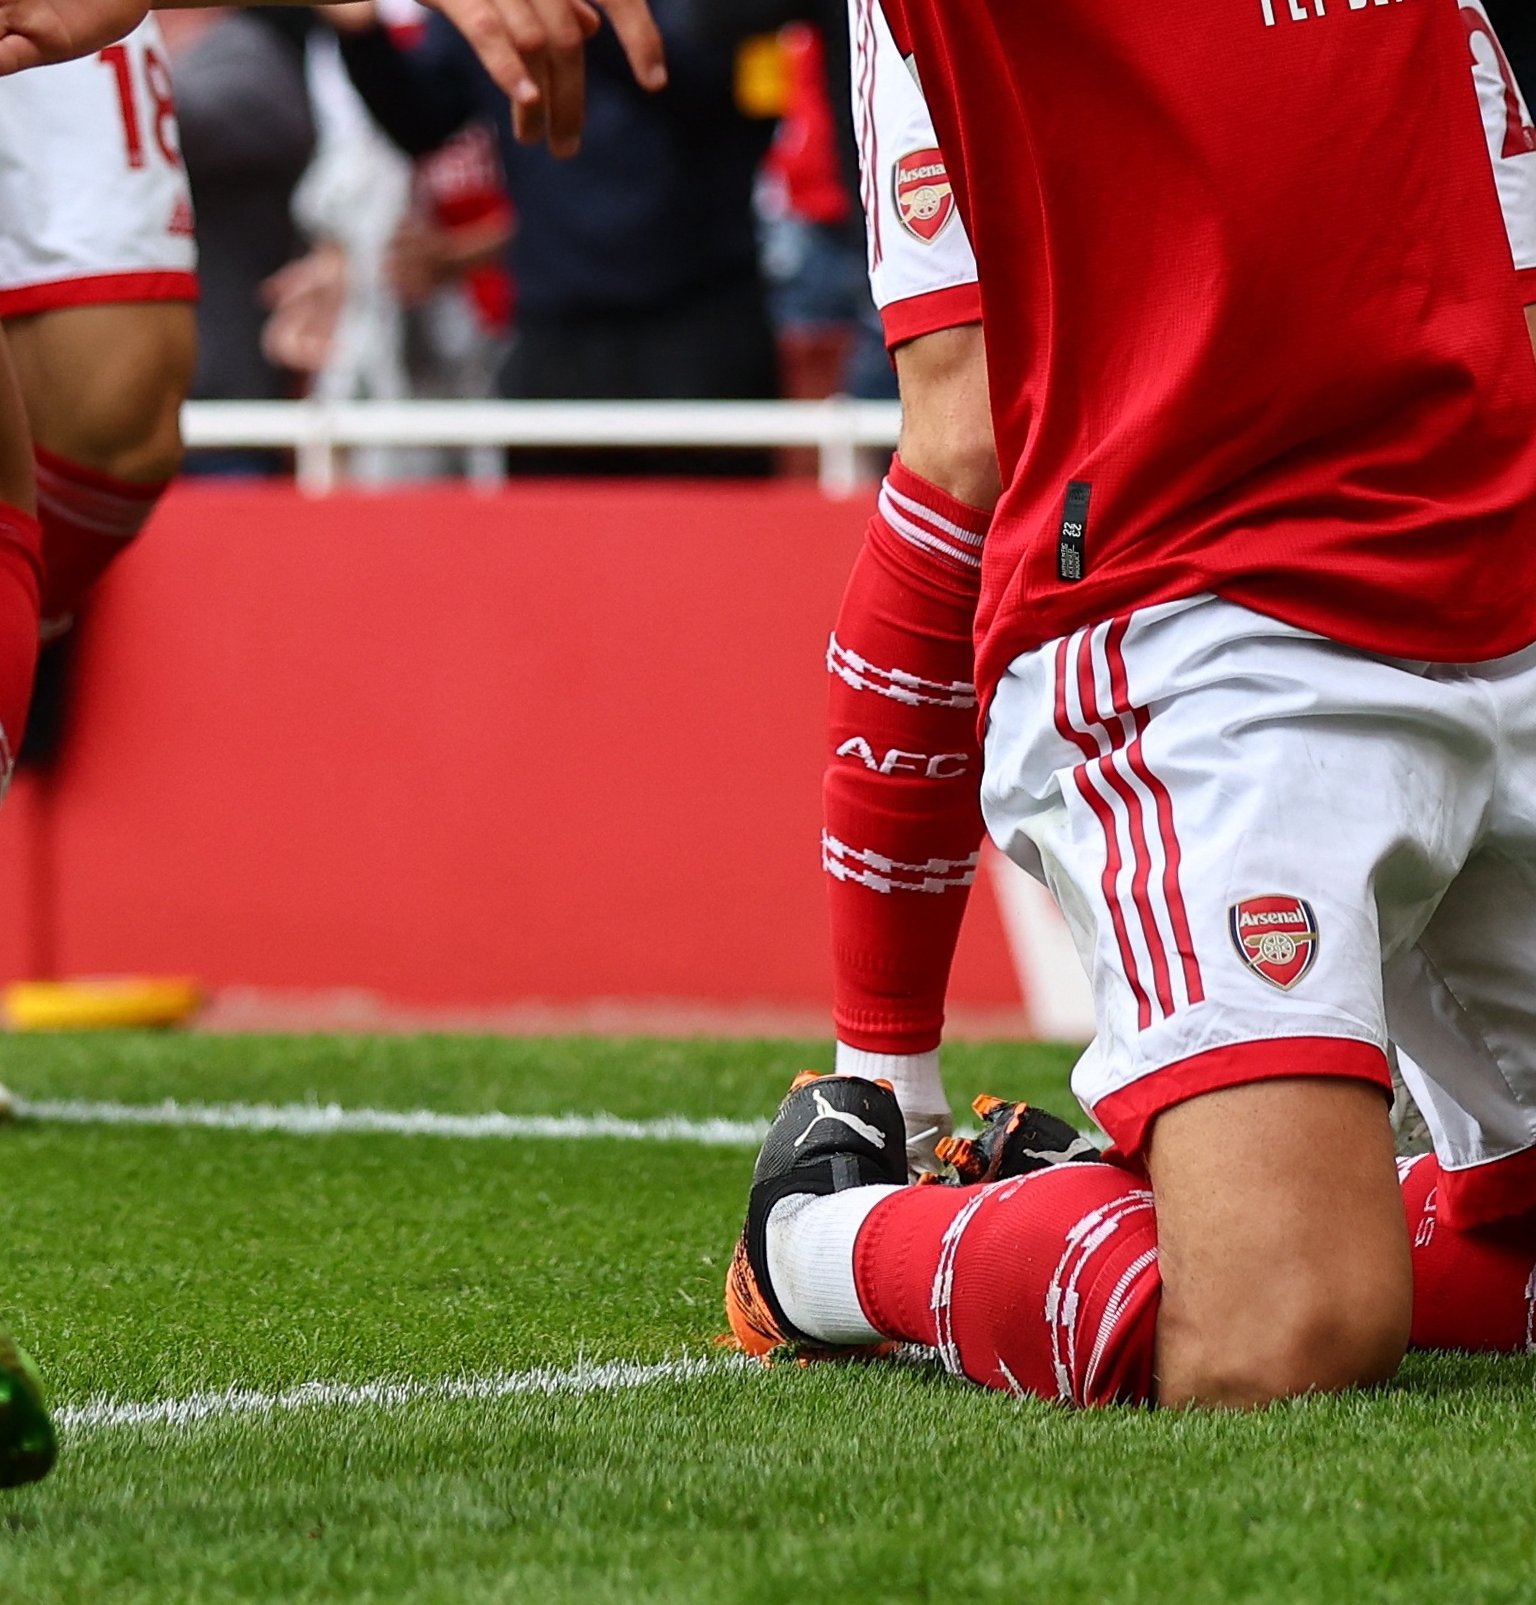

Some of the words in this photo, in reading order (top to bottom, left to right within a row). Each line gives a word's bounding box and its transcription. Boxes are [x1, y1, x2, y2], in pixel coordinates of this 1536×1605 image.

[898, 163, 947, 184] Arsena
[835, 736, 969, 779] AFC
[1239, 907, 1305, 928] Arsenal
